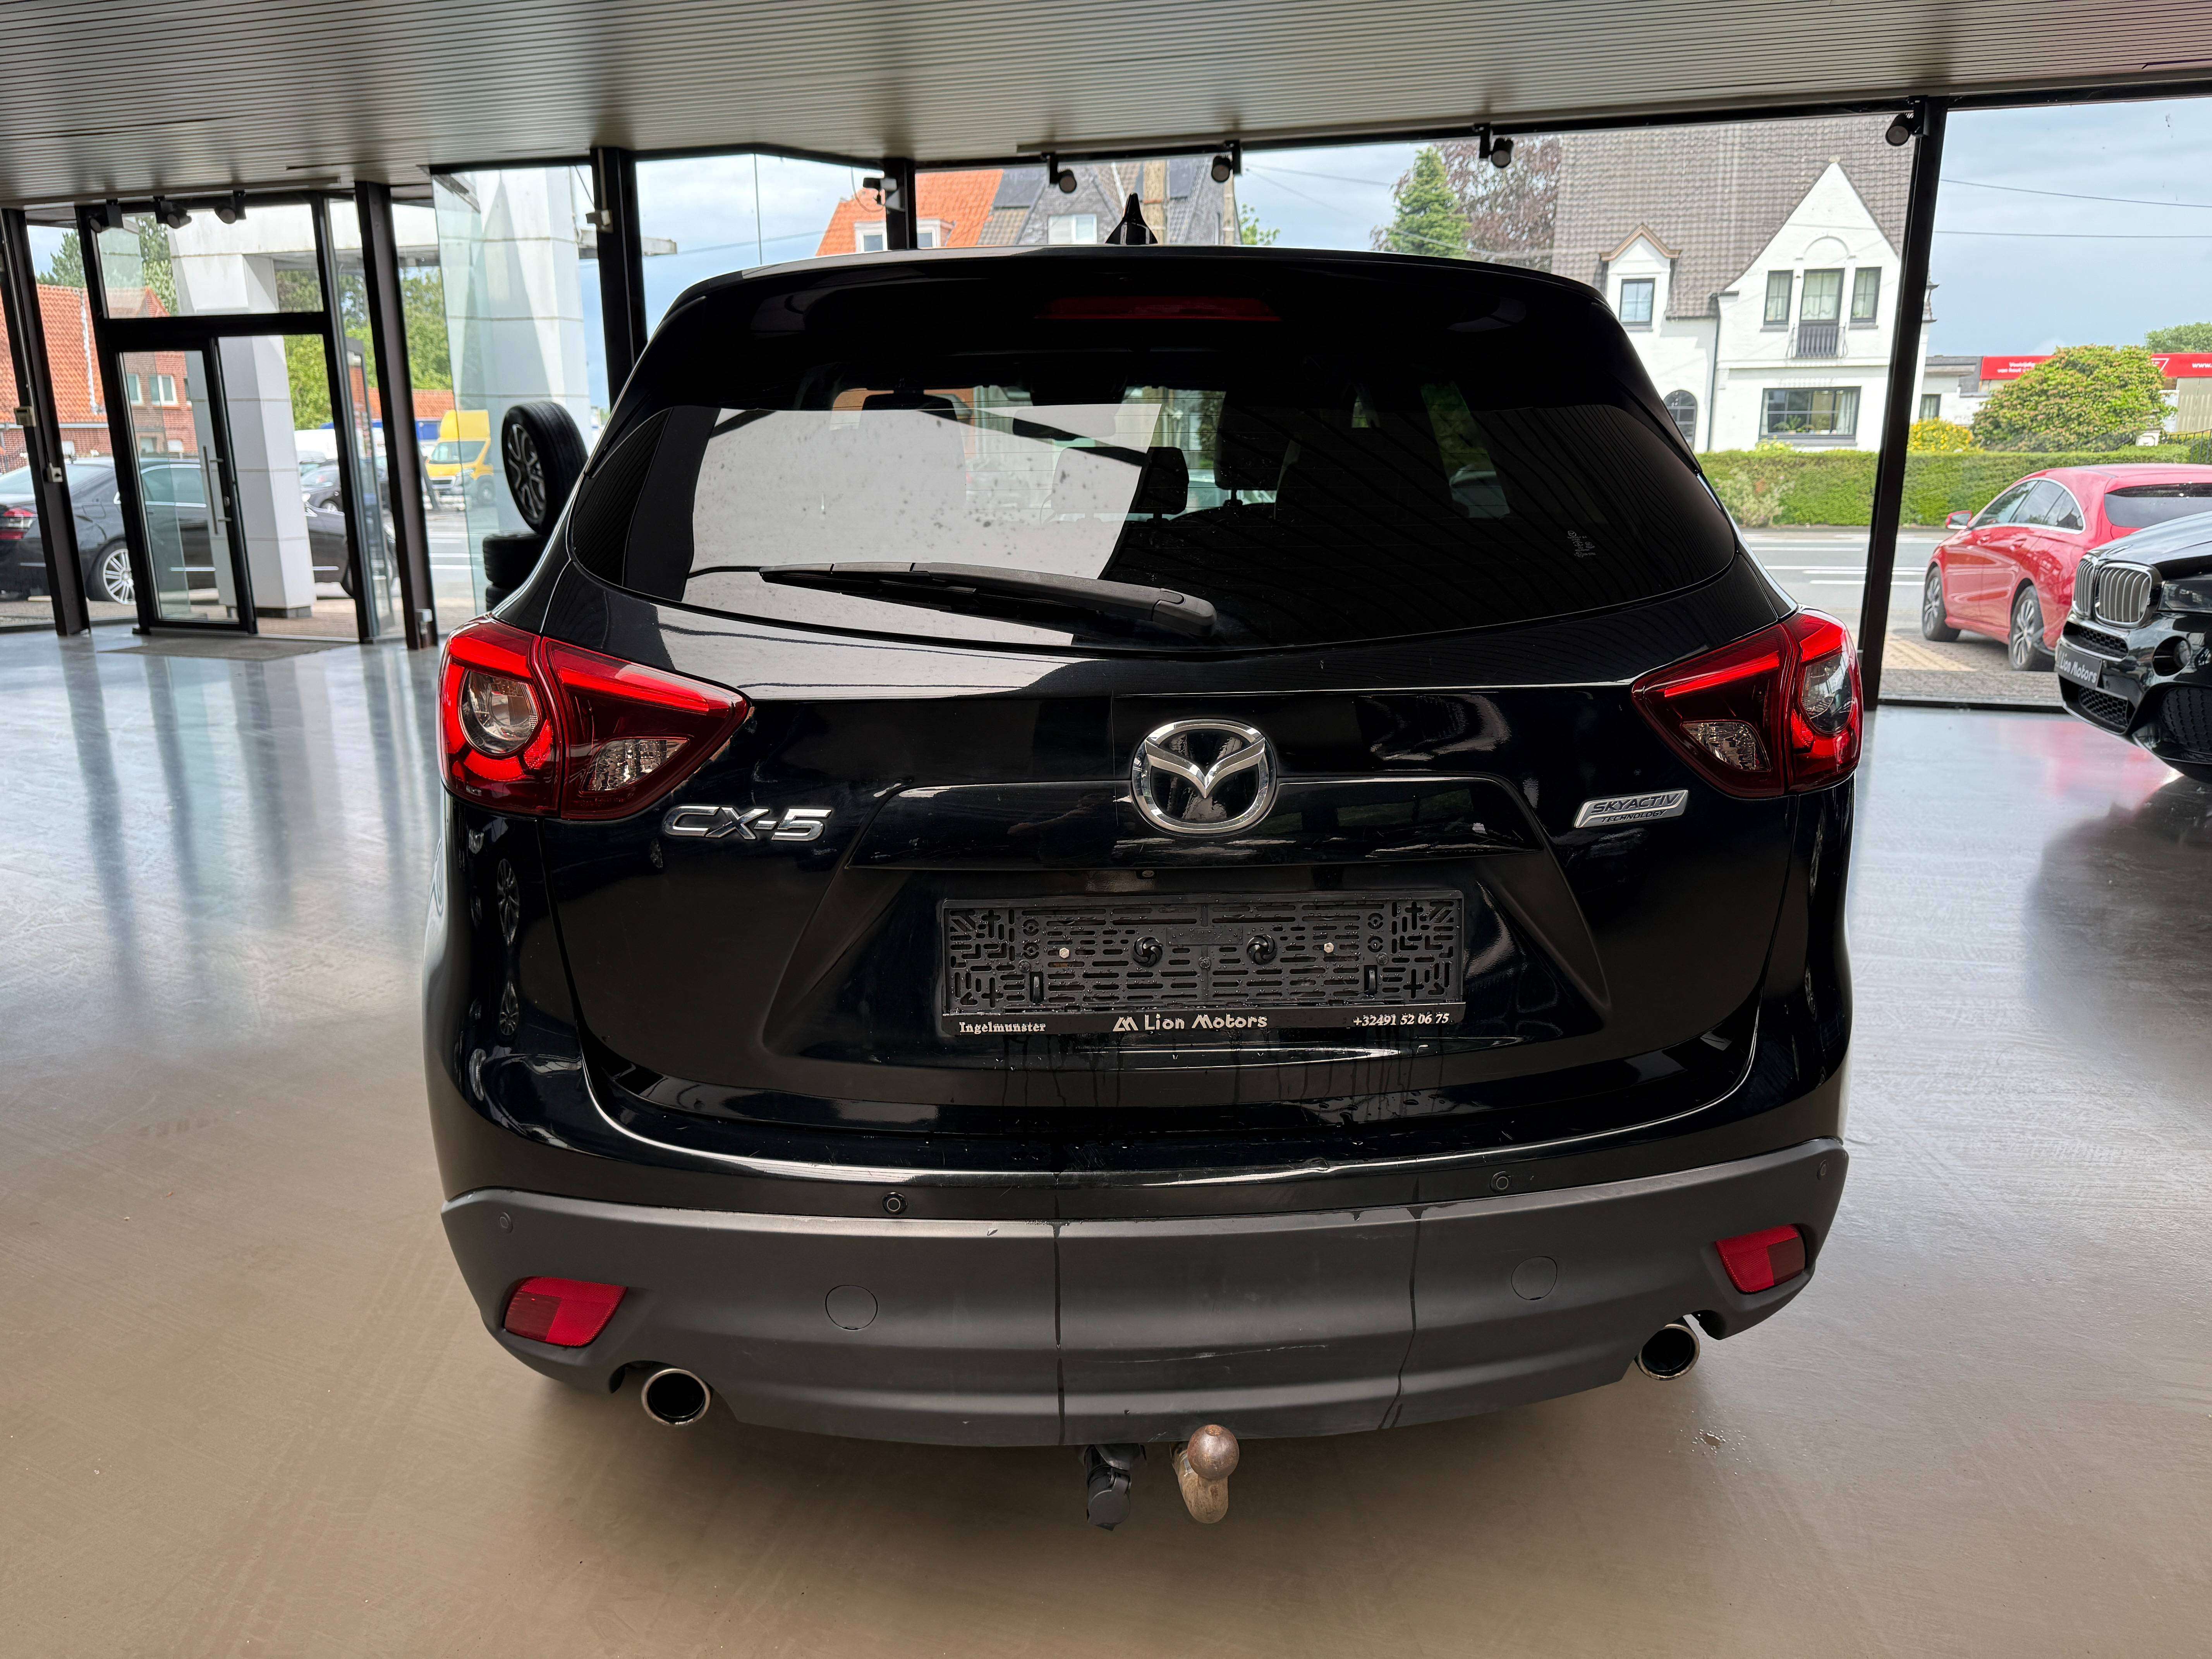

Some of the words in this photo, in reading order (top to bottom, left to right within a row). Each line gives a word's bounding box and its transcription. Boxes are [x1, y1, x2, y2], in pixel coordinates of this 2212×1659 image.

[2060, 652, 2071, 673] Lion
[2070, 661, 2097, 683] Motors
[1591, 793, 1680, 814] SKYACTIV
[664, 805, 832, 841] CX-5
[1601, 809, 1667, 824] TECHNOLOGY
[959, 1021, 1046, 1034] Ingelmunster
[1145, 1013, 1185, 1030] Lion
[1192, 1013, 1267, 1029] Motors
[1353, 1014, 1396, 1026] +32491
[1400, 1013, 1415, 1025] 52
[1417, 1013, 1432, 1024] 06
[1436, 1012, 1450, 1024] 75
